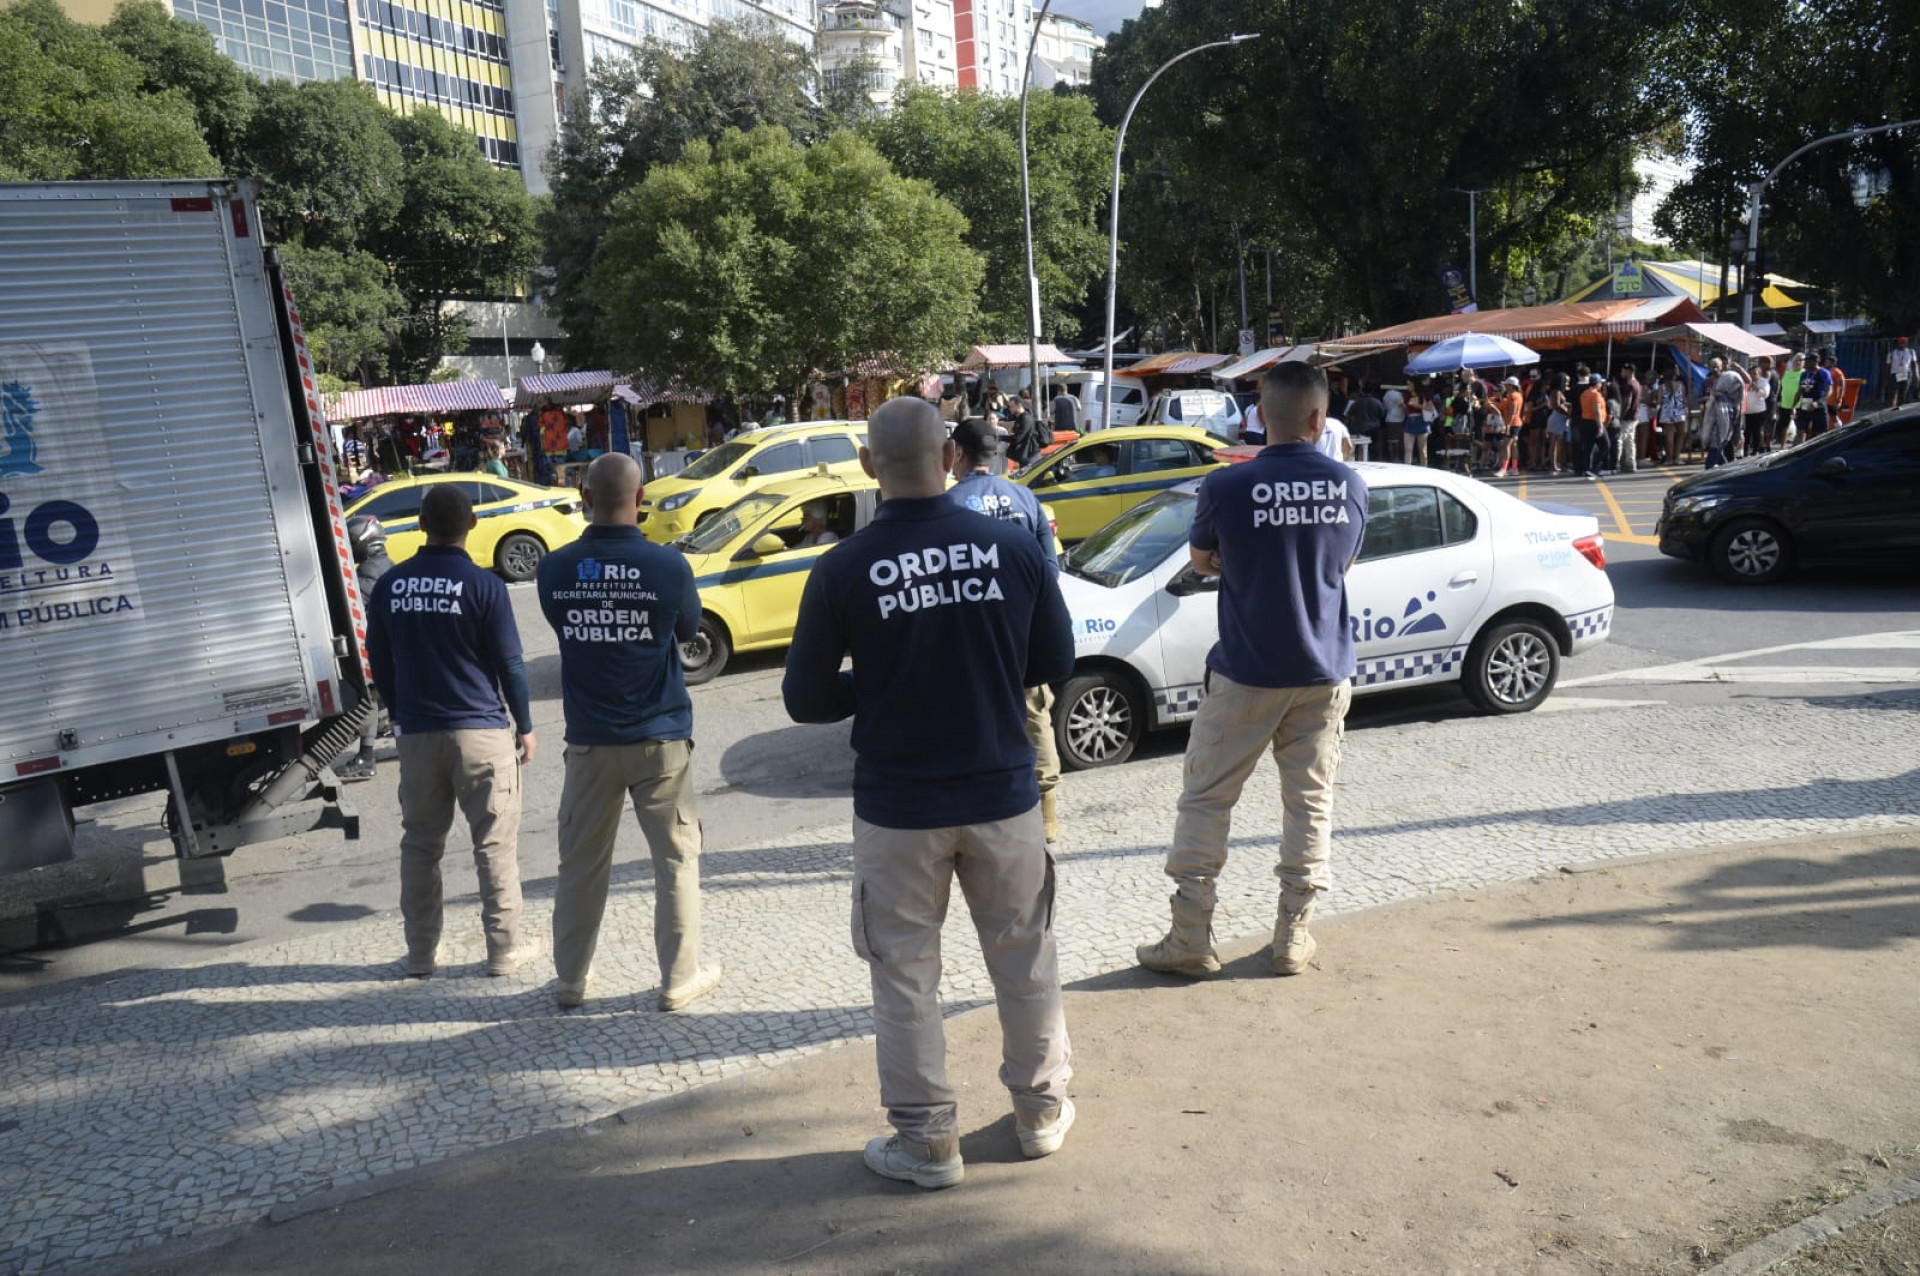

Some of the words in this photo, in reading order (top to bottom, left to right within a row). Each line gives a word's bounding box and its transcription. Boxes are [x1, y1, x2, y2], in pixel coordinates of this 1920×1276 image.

[1251, 480, 1347, 503] ORDEM
[1253, 501, 1350, 528] PÚBLICA
[604, 565, 641, 580] Rio
[869, 542, 1000, 586] ORDEM
[391, 577, 463, 596] ORDEM
[575, 582, 642, 590] PREFEITURA
[390, 593, 463, 615] PÚBLICA
[552, 590, 607, 600] SECRETARIA
[609, 591, 659, 601] MUNICIPAL
[878, 577, 1005, 620] PÚBLICA
[17, 594, 134, 627] PÚBLICA
[601, 601, 614, 609] DE
[566, 609, 649, 625] ORDEM
[1085, 618, 1117, 634] Rio
[562, 624, 654, 642] PÚBLICA
